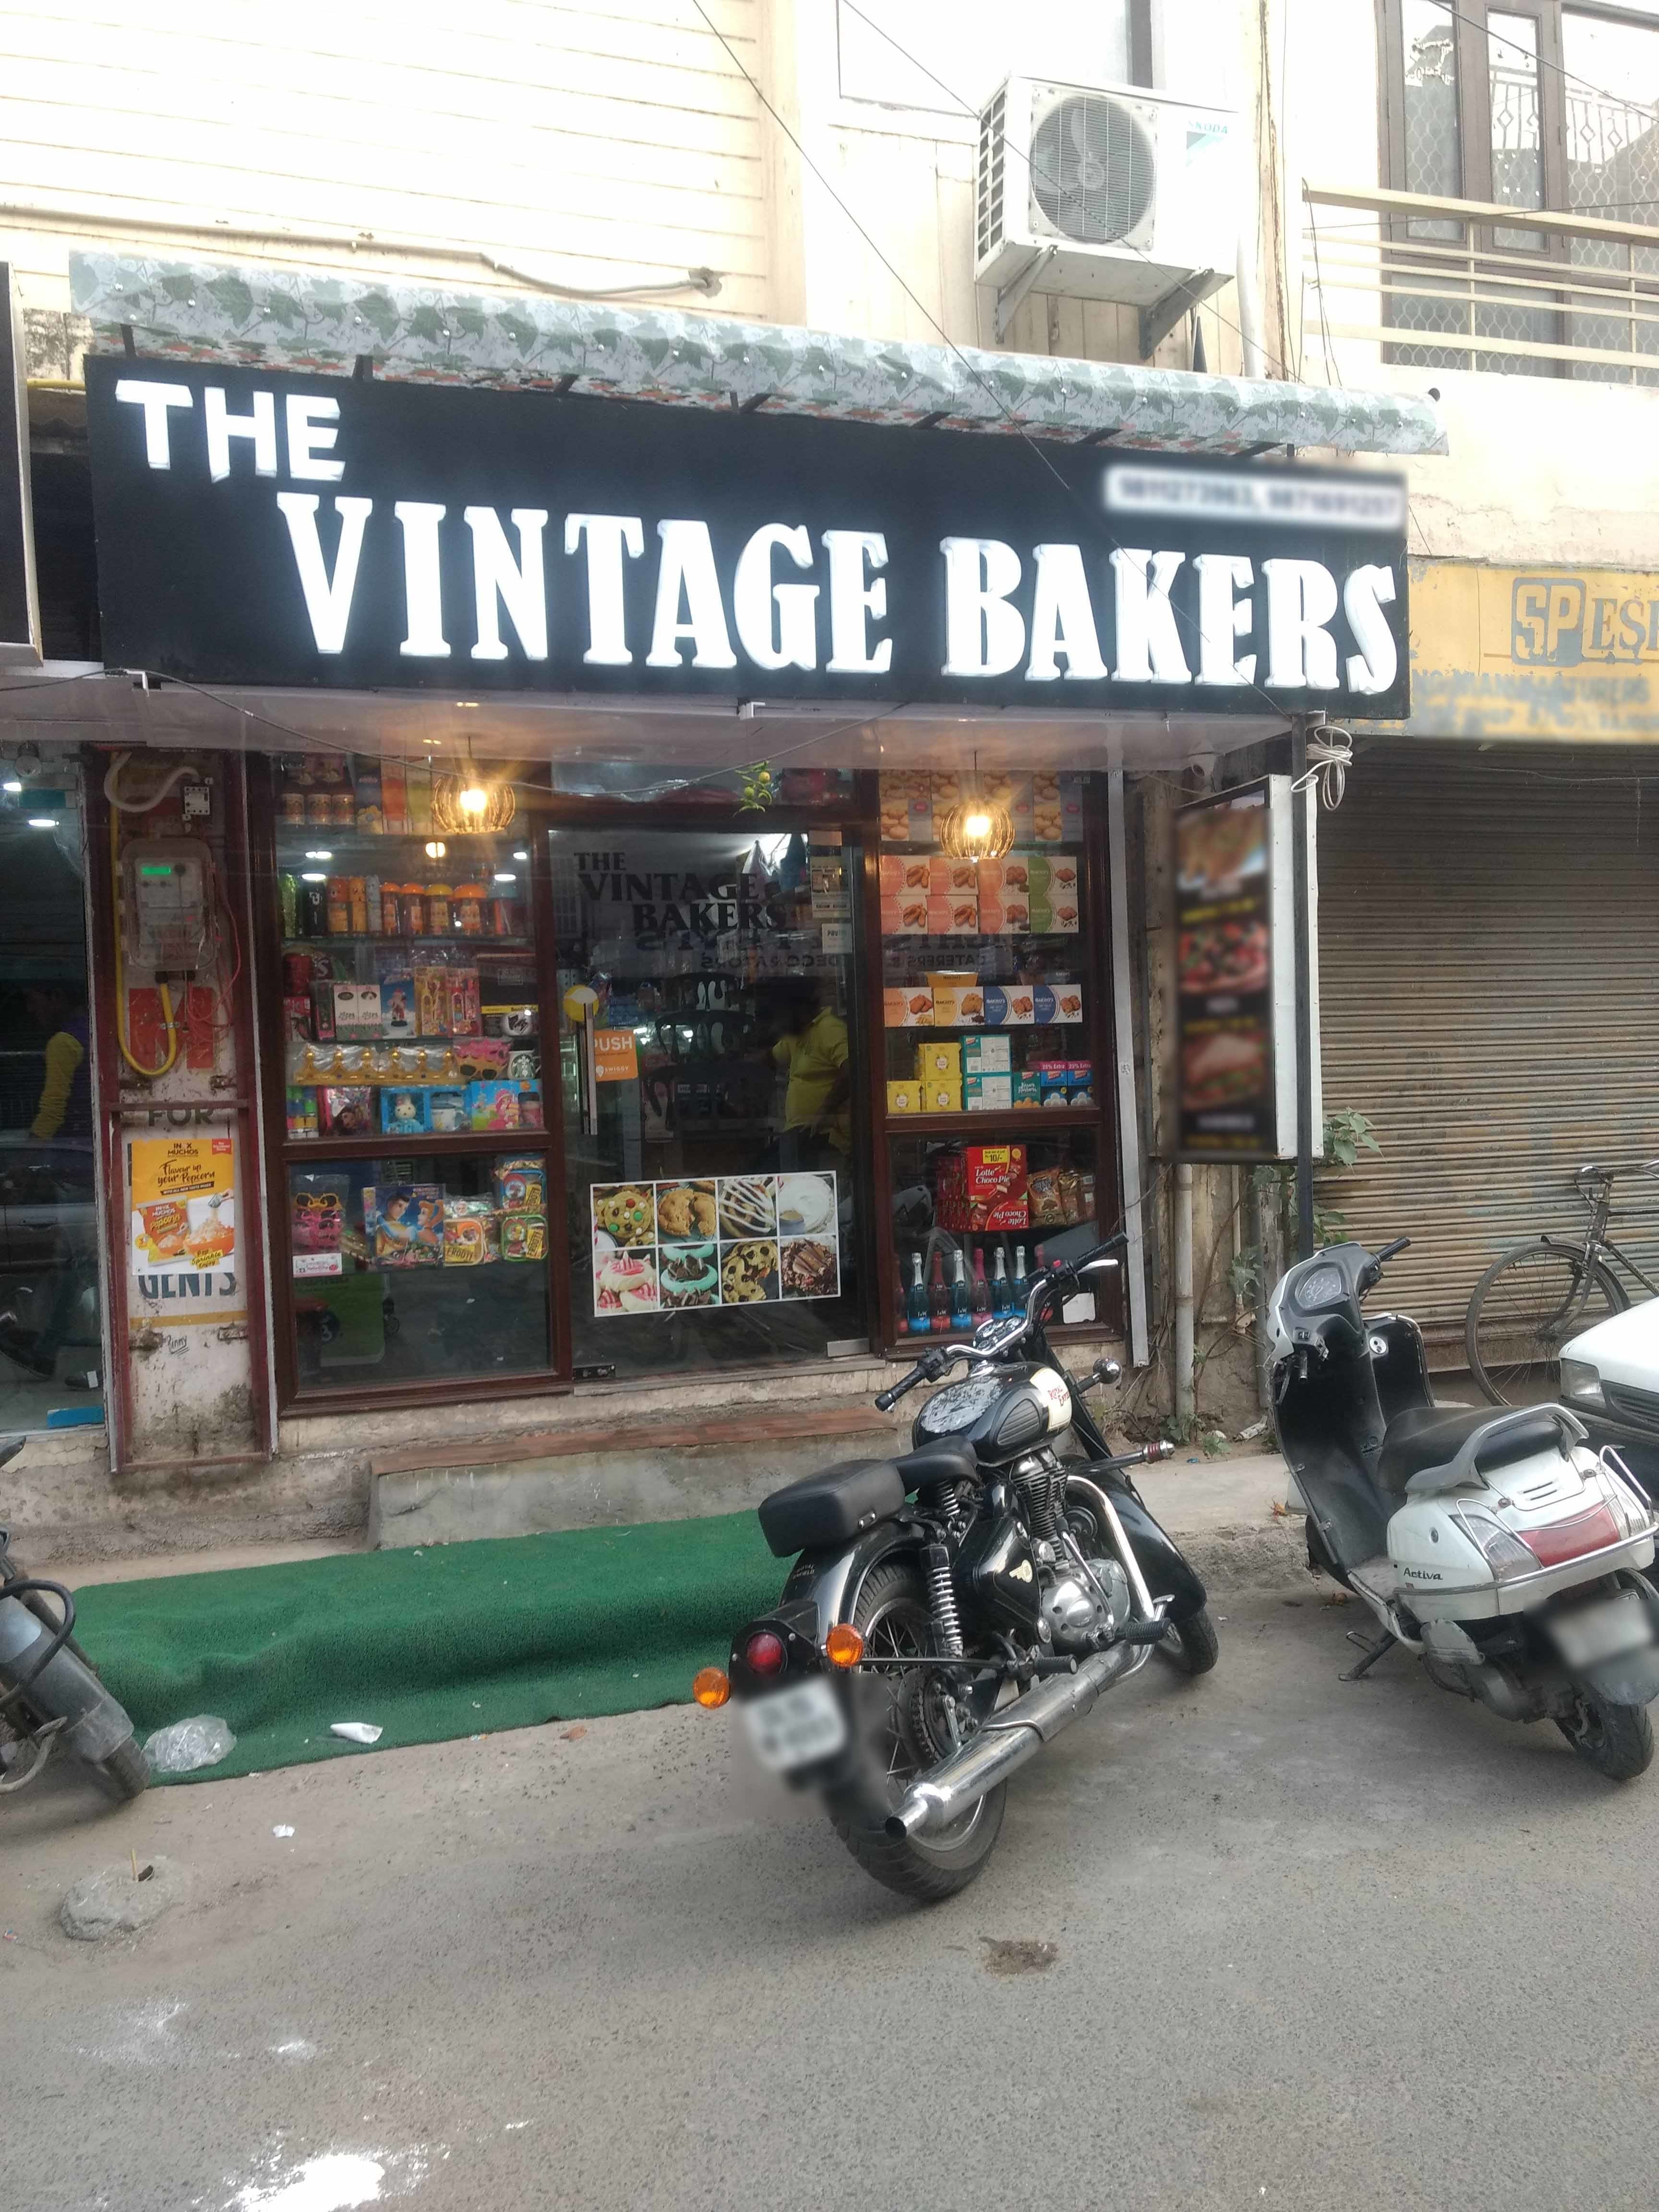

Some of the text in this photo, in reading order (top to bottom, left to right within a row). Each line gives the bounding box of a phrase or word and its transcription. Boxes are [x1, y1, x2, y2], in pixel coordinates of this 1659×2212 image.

[115, 379, 347, 483] THE
[276, 492, 1397, 696] VINTAGE BAKERS
[1515, 583, 1582, 662] SP
[574, 852, 626, 871] THE
[577, 872, 760, 902] VINTAGE
[632, 902, 786, 930] BAKERS
[159, 1159, 202, 1176] Flavour up
[976, 1168, 995, 1177] Lotte
[157, 1171, 215, 1187] your Popcorn
[975, 1176, 998, 1184] Choco
[1403, 1567, 1443, 1580] Activa
